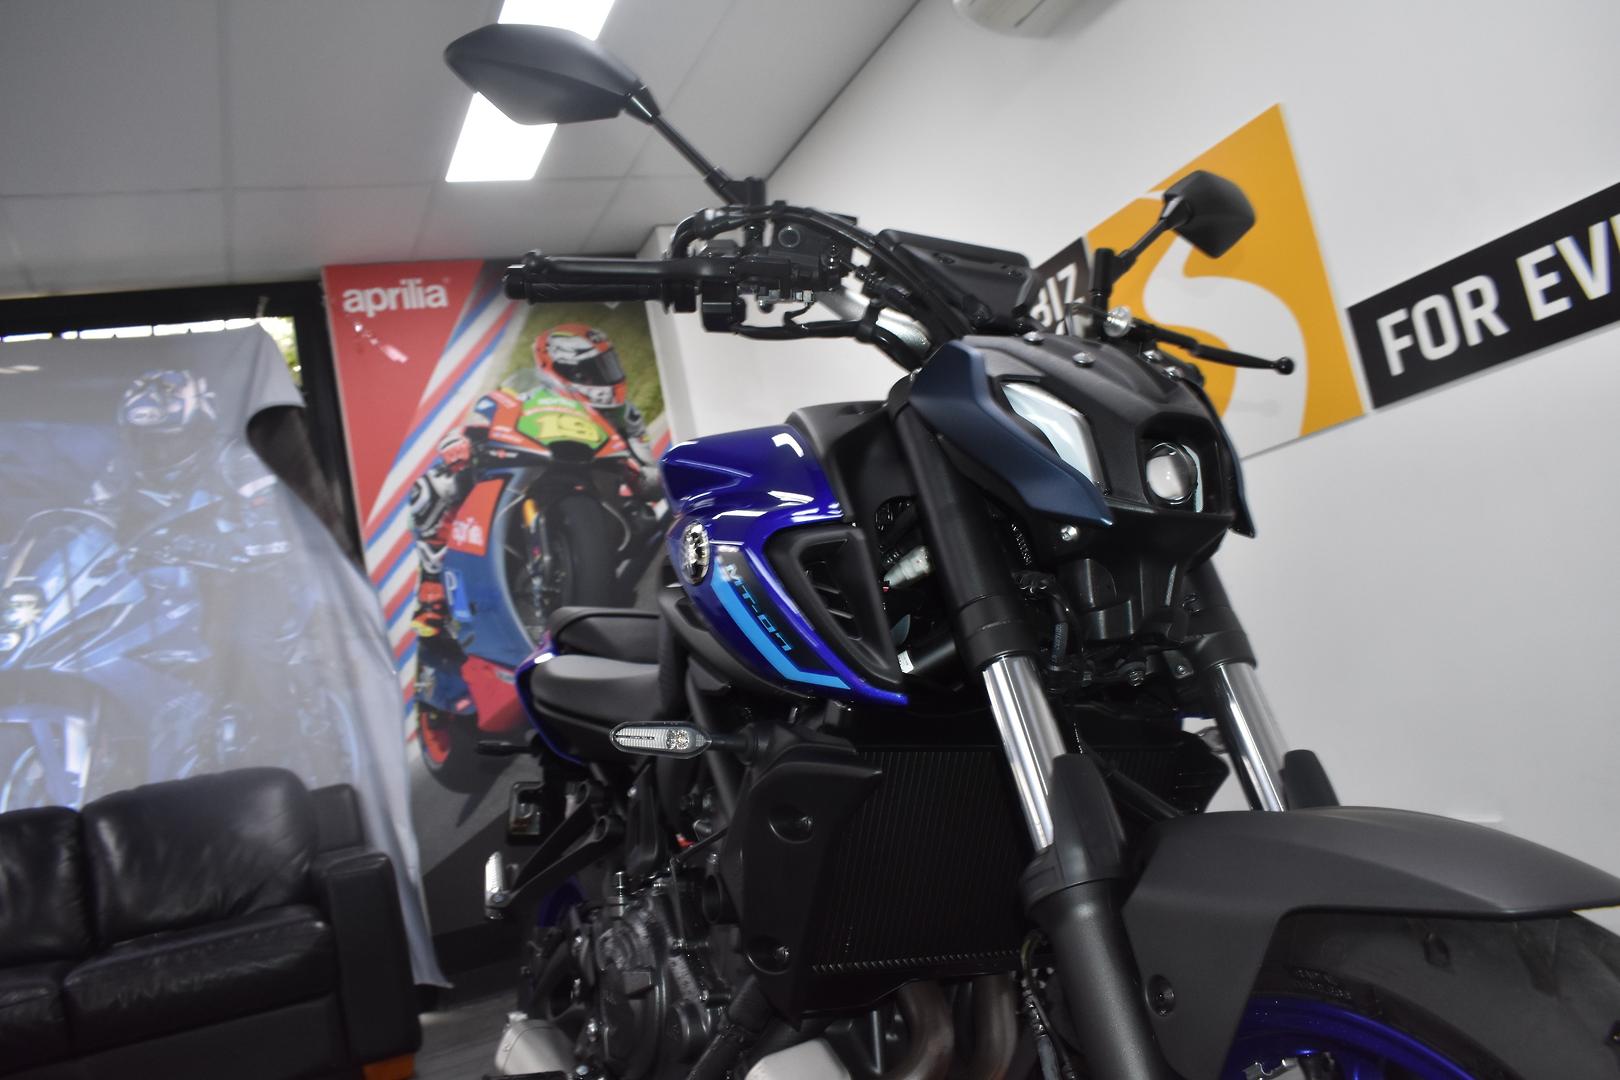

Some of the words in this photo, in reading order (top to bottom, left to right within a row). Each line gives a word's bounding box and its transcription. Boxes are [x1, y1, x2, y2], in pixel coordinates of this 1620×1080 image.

[342, 277, 449, 318] aprilia
[1376, 274, 1510, 377] FOR
[1516, 212, 1620, 322] EV
